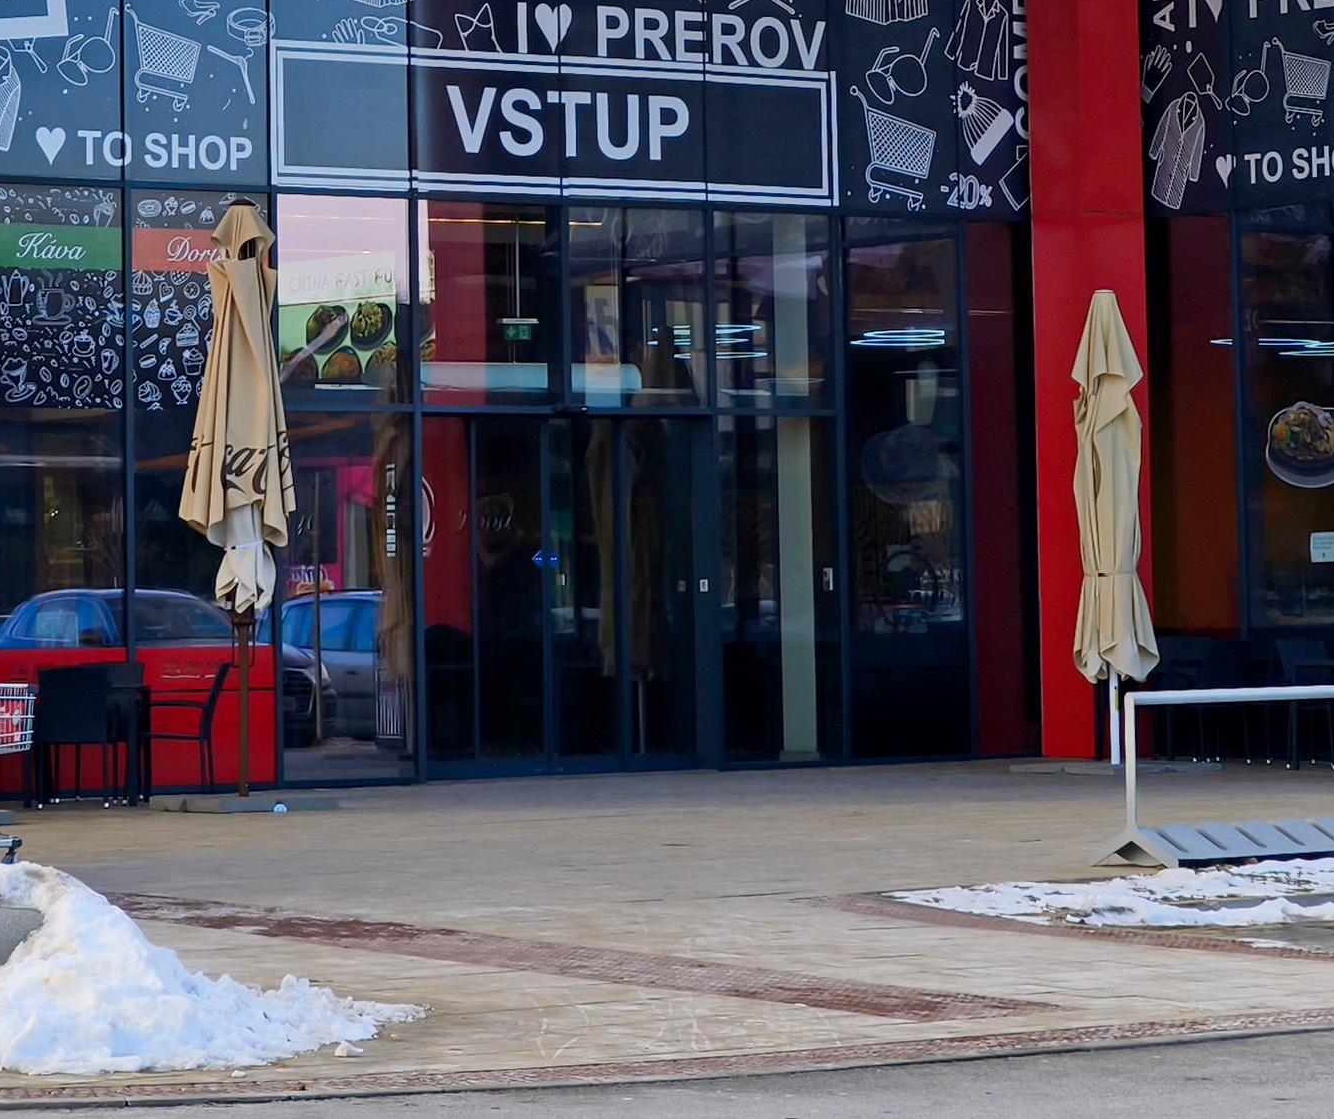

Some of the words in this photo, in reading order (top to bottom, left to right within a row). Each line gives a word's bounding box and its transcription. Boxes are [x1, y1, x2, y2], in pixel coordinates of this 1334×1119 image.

[517, 1, 528, 53] I
[596, 4, 827, 71] PREROV
[446, 84, 690, 161] VSTUP
[77, 129, 132, 168] TO
[143, 131, 253, 171] SHOP
[1245, 152, 1283, 184] TO
[940, 172, 993, 210] -20%
[15, 231, 87, 260] Káva
[167, 236, 221, 263] Dort
